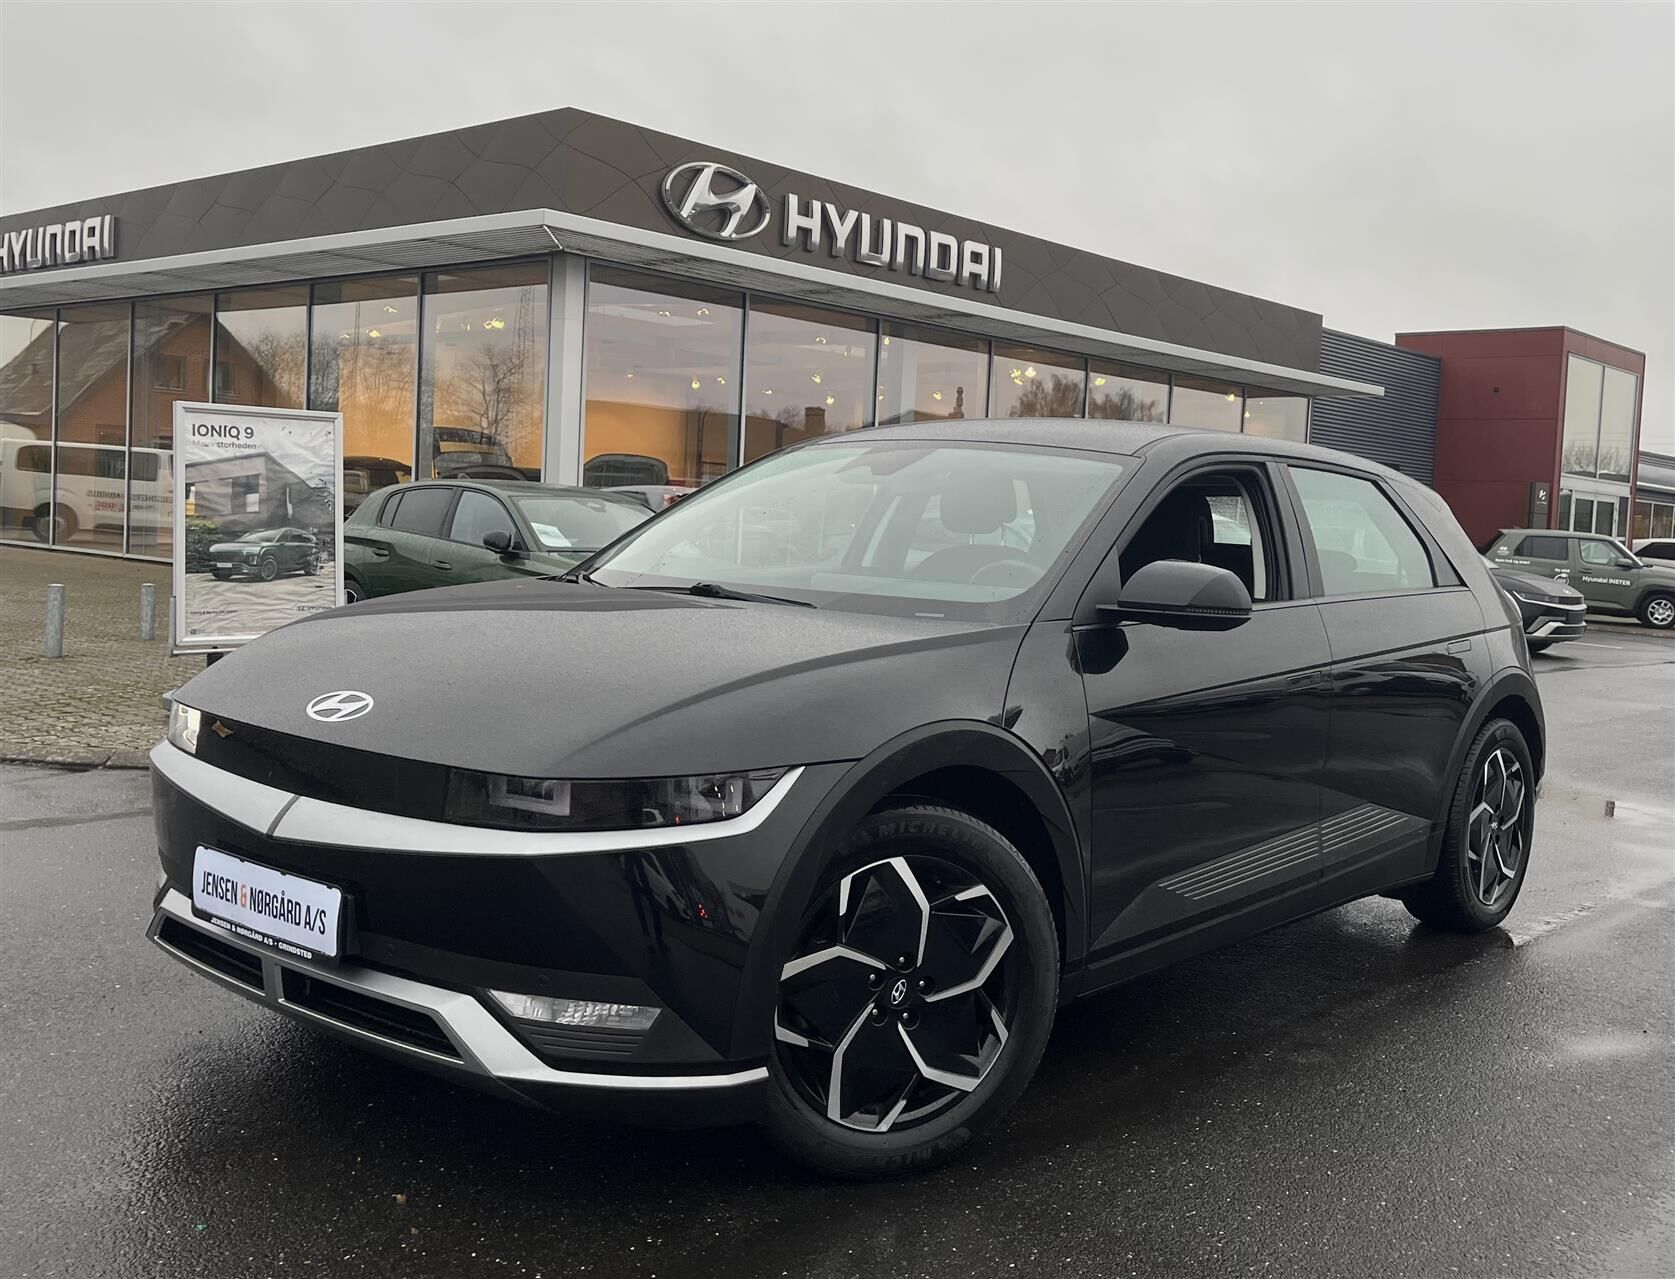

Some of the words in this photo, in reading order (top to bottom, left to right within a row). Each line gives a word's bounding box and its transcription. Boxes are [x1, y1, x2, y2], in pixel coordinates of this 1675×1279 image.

[783, 193, 1002, 293] HYUNDAI
[192, 423, 240, 441] IONIQ
[244, 426, 254, 439] 9
[216, 441, 257, 450] storheden
[1582, 575, 1608, 584] Hyundai
[1608, 579, 1631, 587] INSTER
[201, 870, 238, 906] JENSEN
[240, 884, 247, 908] &
[249, 886, 302, 927] NØRGÅRD
[304, 904, 327, 935] A/S
[210, 916, 232, 932] JENSEN
[231, 924, 236, 932] &
[278, 941, 312, 959] GRINDSTED
